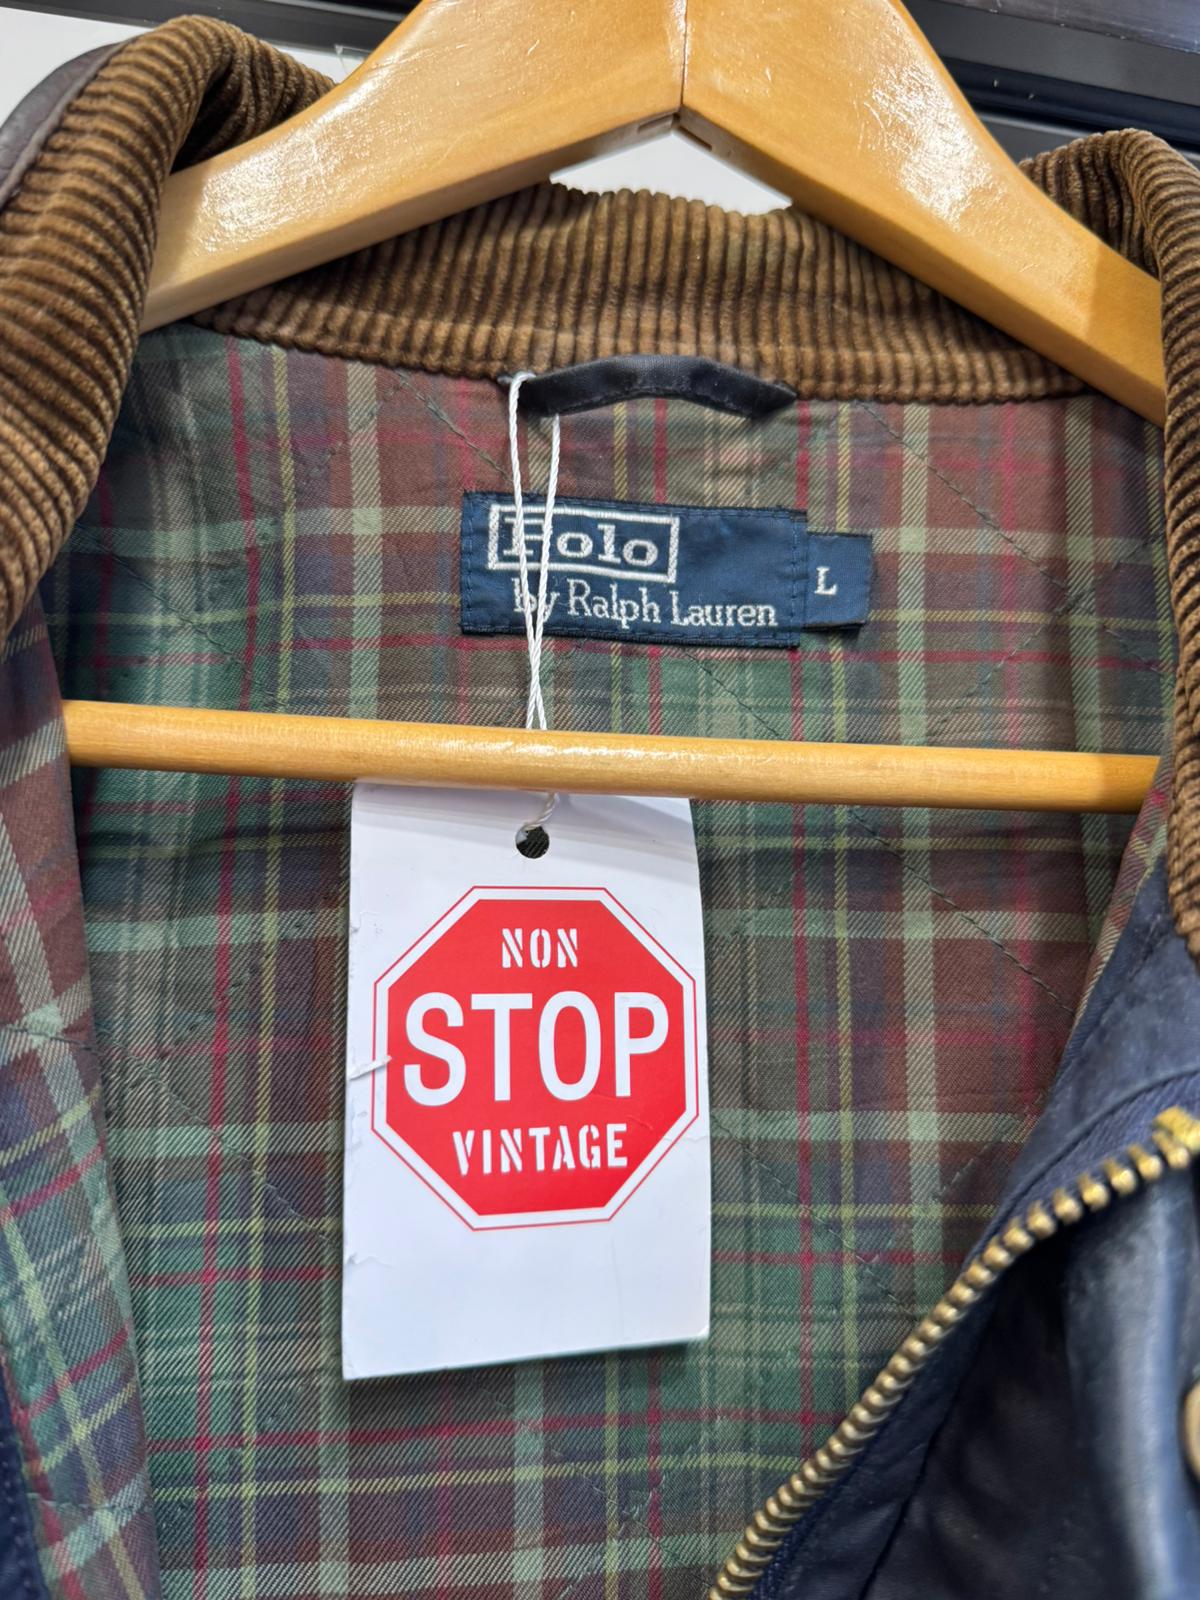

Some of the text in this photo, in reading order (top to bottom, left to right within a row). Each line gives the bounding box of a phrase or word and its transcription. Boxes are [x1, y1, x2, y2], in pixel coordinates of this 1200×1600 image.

[567, 578, 662, 629] Ralph
[670, 591, 778, 627] Lauren
[814, 566, 838, 596] L
[501, 928, 578, 968] NON
[403, 991, 669, 1107] STOP
[452, 1123, 628, 1177] VINTAGE
